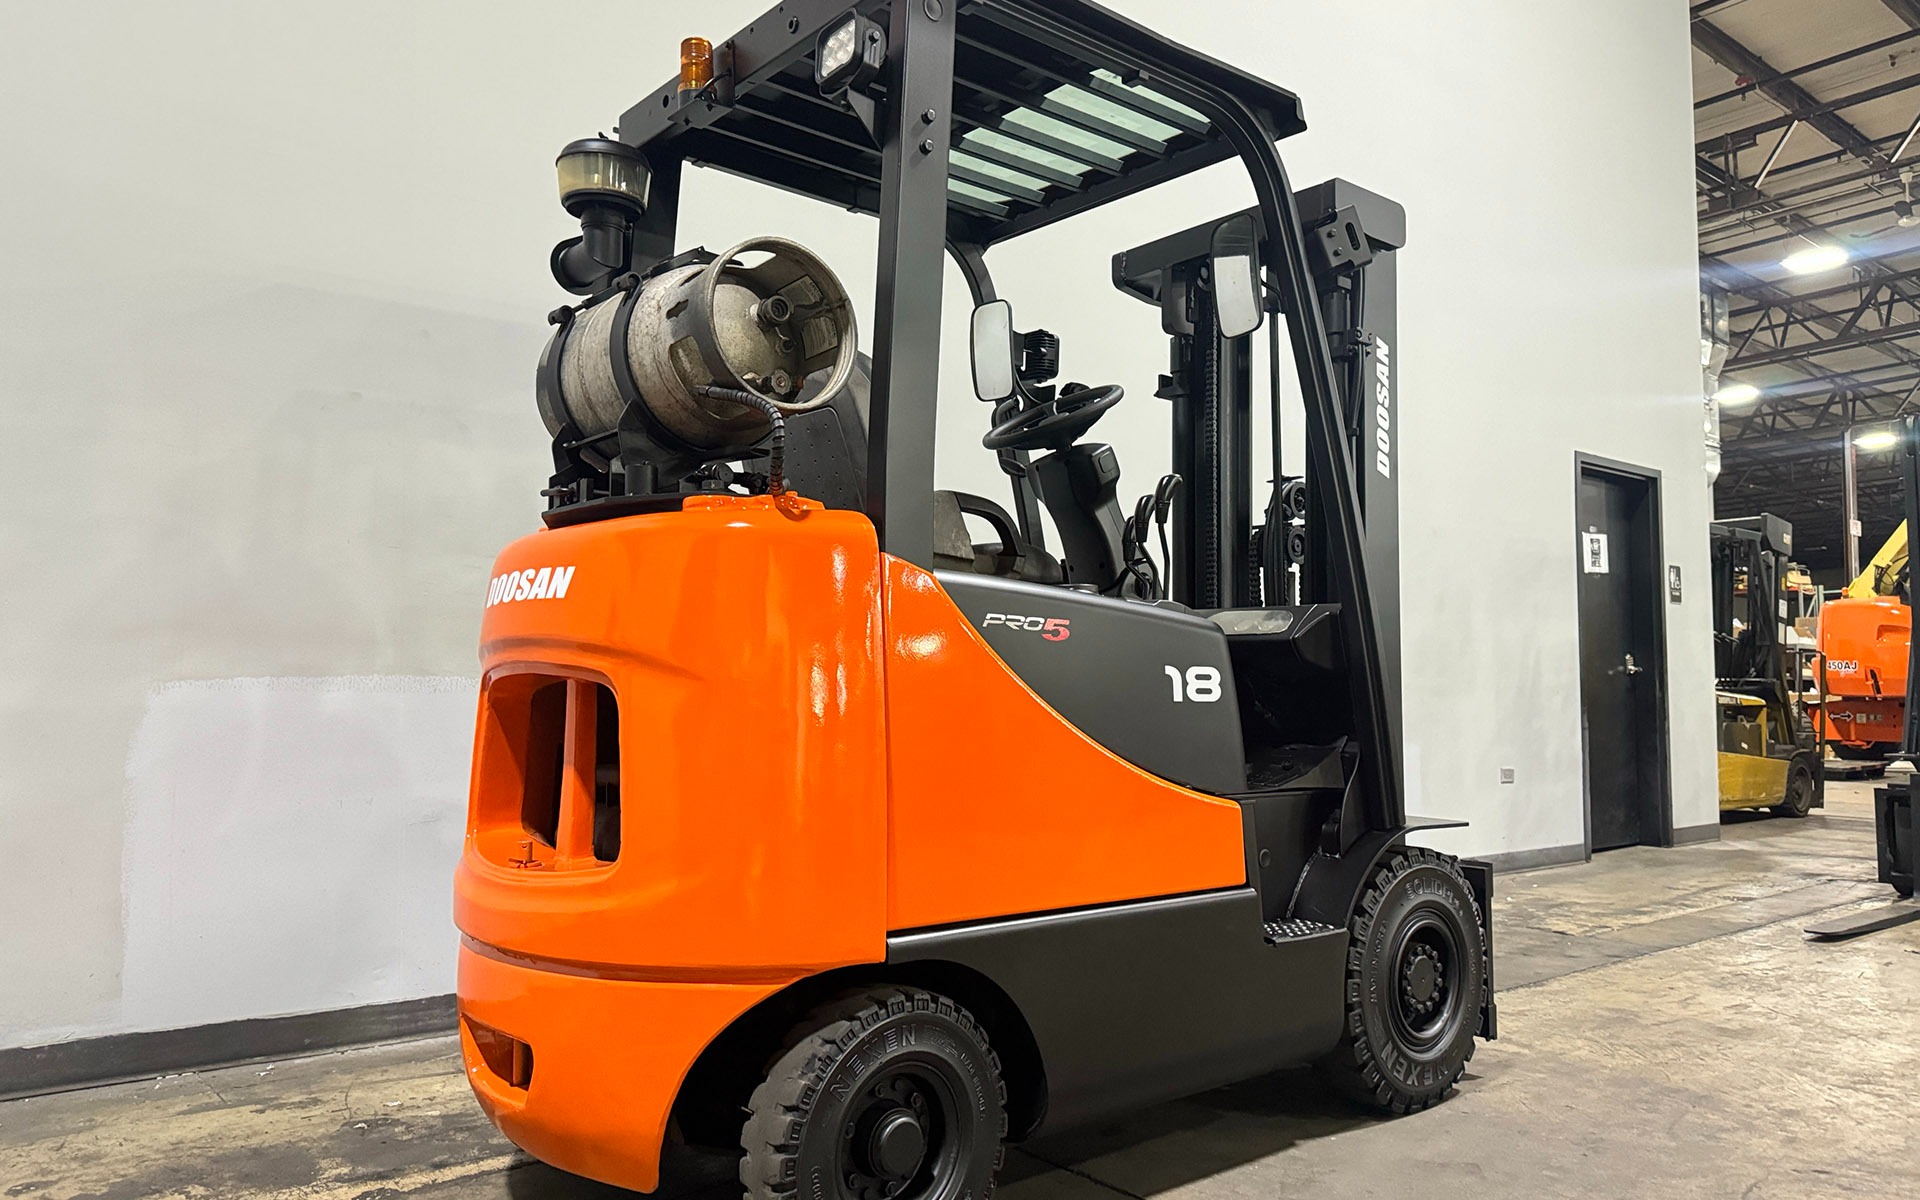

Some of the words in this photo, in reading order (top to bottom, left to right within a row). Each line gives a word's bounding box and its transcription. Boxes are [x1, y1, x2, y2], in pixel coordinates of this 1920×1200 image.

[1376, 336, 1390, 479] DOOSAN
[486, 566, 576, 608] DOOSAN
[982, 613, 1070, 641] PRO5
[1164, 665, 1222, 703] 18
[1827, 660, 1858, 671] 450AJ
[830, 1024, 916, 1102] NEXEN
[1381, 1040, 1448, 1086] NEXEN
